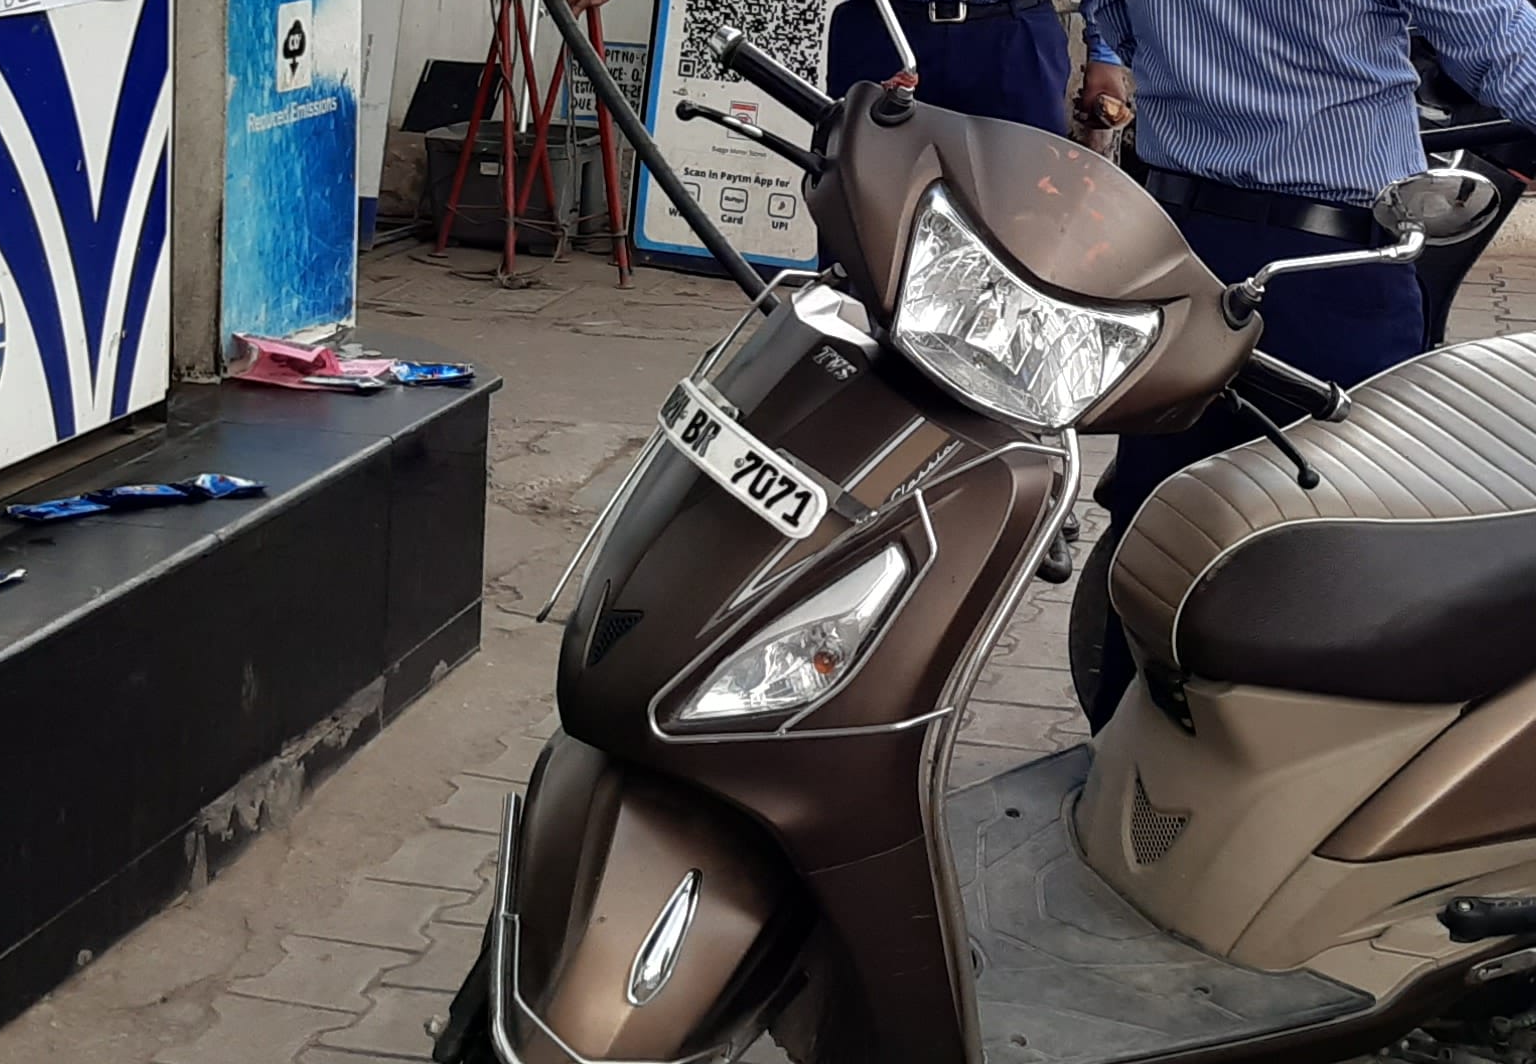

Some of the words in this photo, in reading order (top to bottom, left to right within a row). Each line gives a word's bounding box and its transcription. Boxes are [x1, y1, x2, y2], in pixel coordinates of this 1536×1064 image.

[291, 95, 338, 120] Emissions
[684, 167, 707, 179] Scan
[708, 169, 718, 179] in
[720, 172, 752, 185] Paytm
[753, 175, 773, 187] App
[775, 177, 790, 188] for
[721, 215, 744, 224] Card
[772, 222, 789, 231] UPI
[814, 346, 857, 381] TVS
[731, 451, 813, 528] 7071
